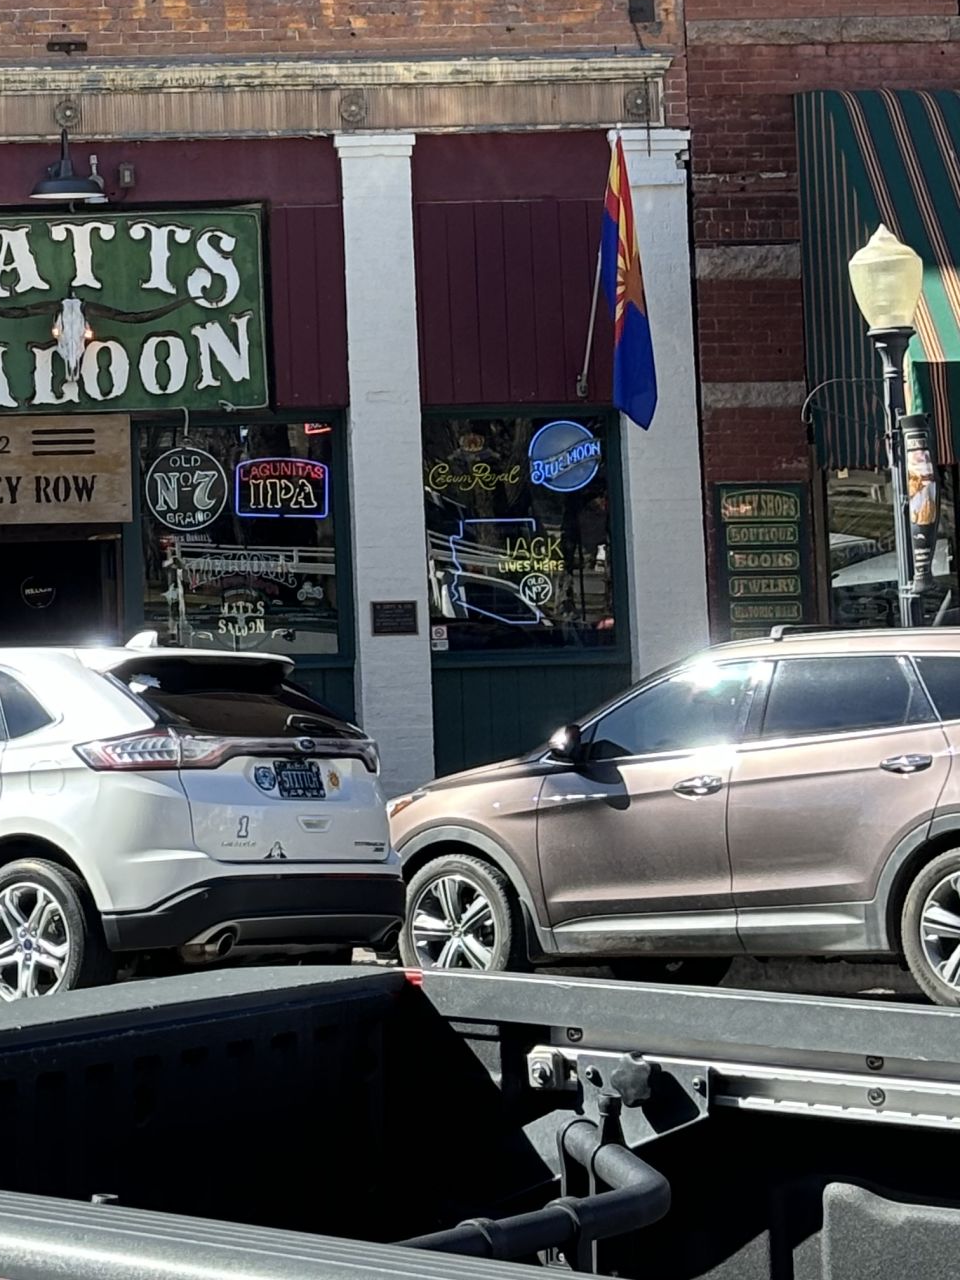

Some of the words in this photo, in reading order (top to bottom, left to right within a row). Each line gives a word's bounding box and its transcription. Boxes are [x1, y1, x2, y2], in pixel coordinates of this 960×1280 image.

[169, 455, 201, 468] OLD
[240, 462, 324, 481] LAGUNITAS
[531, 458, 564, 484] BLUE
[565, 440, 601, 466] MOON
[459, 463, 520, 491] Royal
[34, 475, 97, 503] ROW
[249, 479, 317, 509] IPA
[761, 494, 795, 517] SHOPS
[731, 527, 794, 541] BOUTIQUE
[499, 537, 564, 559] JACK
[498, 560, 531, 573] LIVES
[533, 560, 565, 571] HERE
[734, 553, 793, 568] BOOKS
